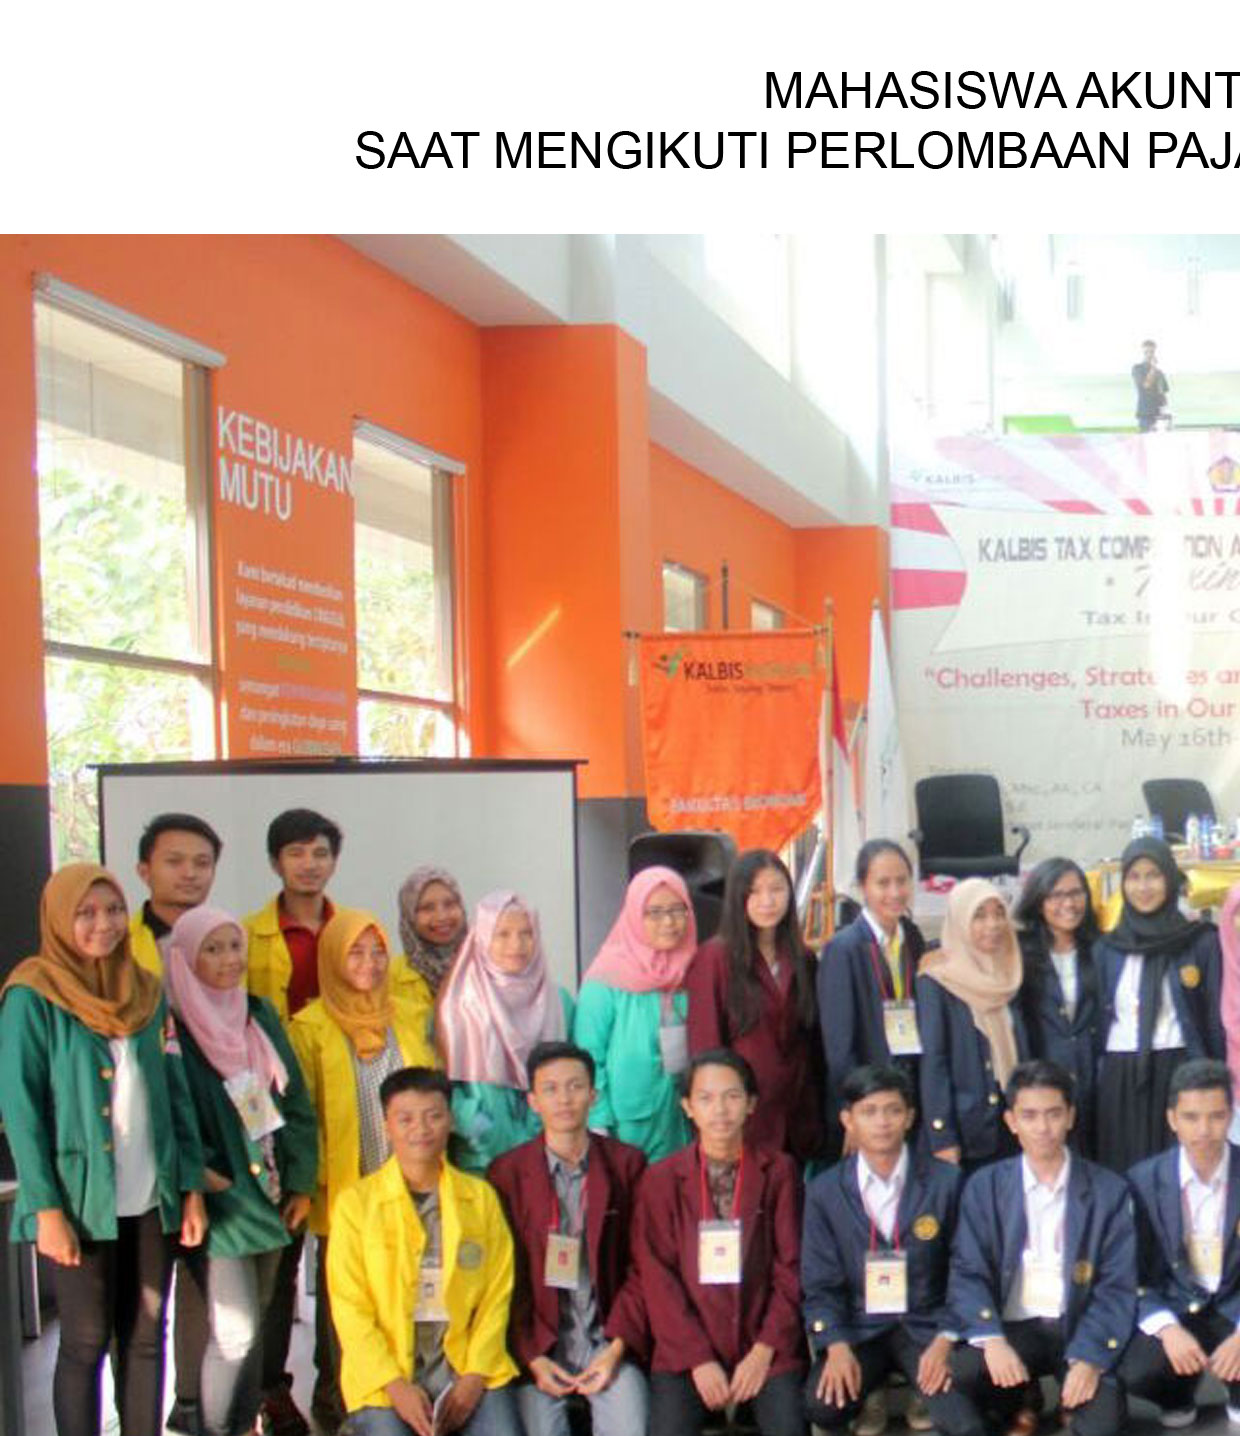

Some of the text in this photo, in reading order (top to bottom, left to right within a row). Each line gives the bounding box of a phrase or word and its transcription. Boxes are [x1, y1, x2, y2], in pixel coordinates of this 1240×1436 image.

[218, 406, 353, 496] KEBIJAKAN
[219, 457, 291, 521] MUTU
[978, 537, 1048, 563] KALBIS
[1054, 536, 1093, 562] TAX
[1082, 610, 1127, 625] Tax
[1080, 698, 1149, 721] Taxes
[1157, 697, 1180, 719] in
[1187, 697, 1234, 719] Our
[1120, 727, 1171, 754] May
